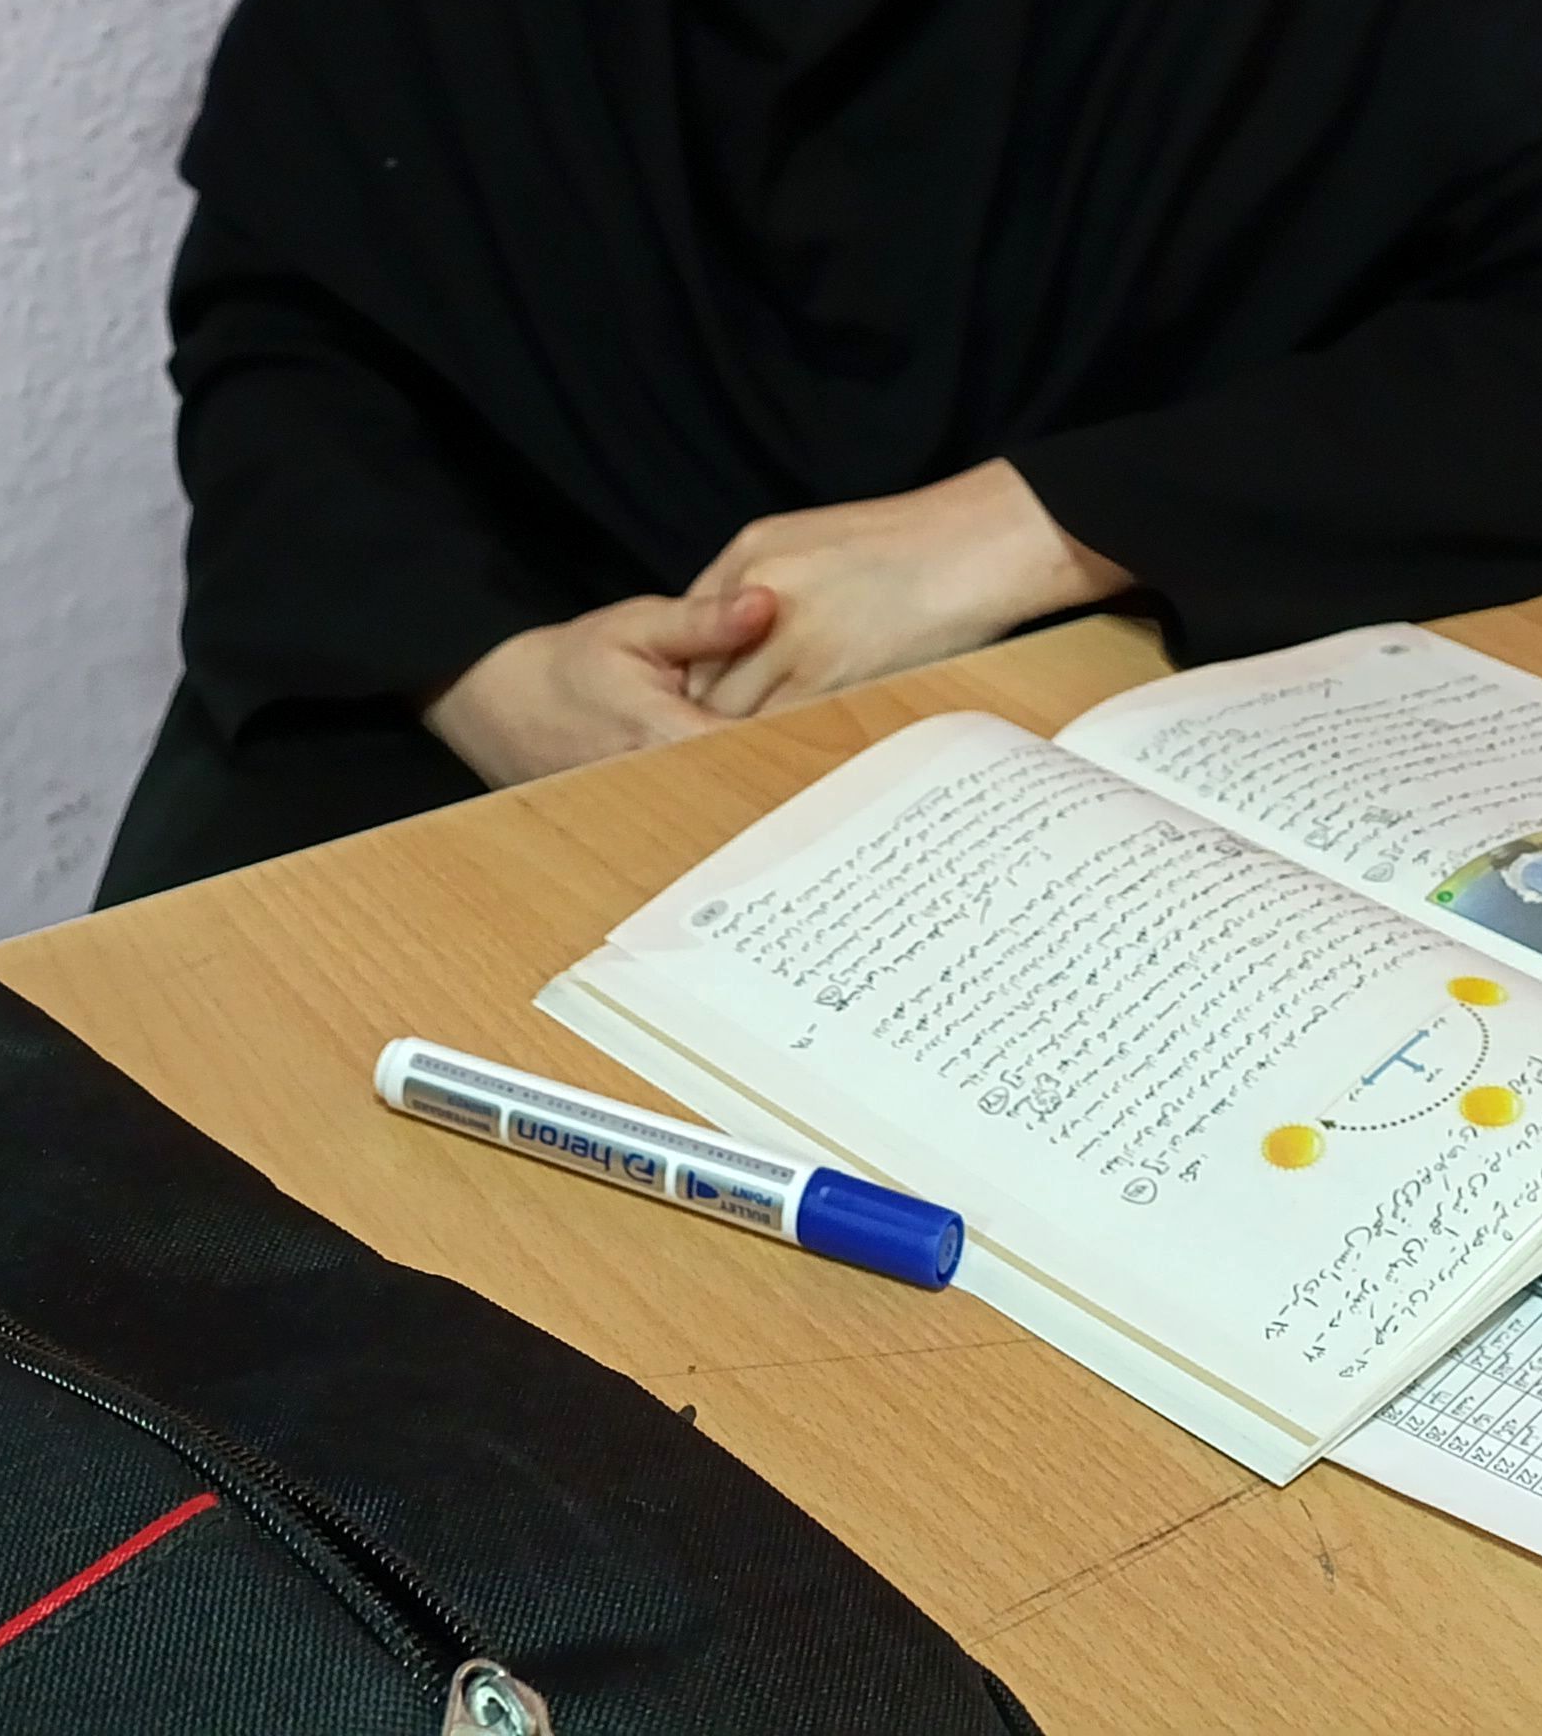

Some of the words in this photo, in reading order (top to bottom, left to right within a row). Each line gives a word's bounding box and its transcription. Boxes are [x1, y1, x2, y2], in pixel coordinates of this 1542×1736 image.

[516, 1116, 613, 1171] heron
[729, 1184, 774, 1209] POINT
[722, 1200, 772, 1226] BULLET
[1379, 1402, 1404, 1421] 28
[1423, 1424, 1447, 1442] 26
[1449, 1394, 1475, 1416] فاطمه
[1403, 1414, 1425, 1432] 27
[1446, 1434, 1470, 1453] 25
[1469, 1444, 1493, 1463] 24
[1491, 1455, 1516, 1474] 23
[1514, 1467, 1539, 1486] 22
